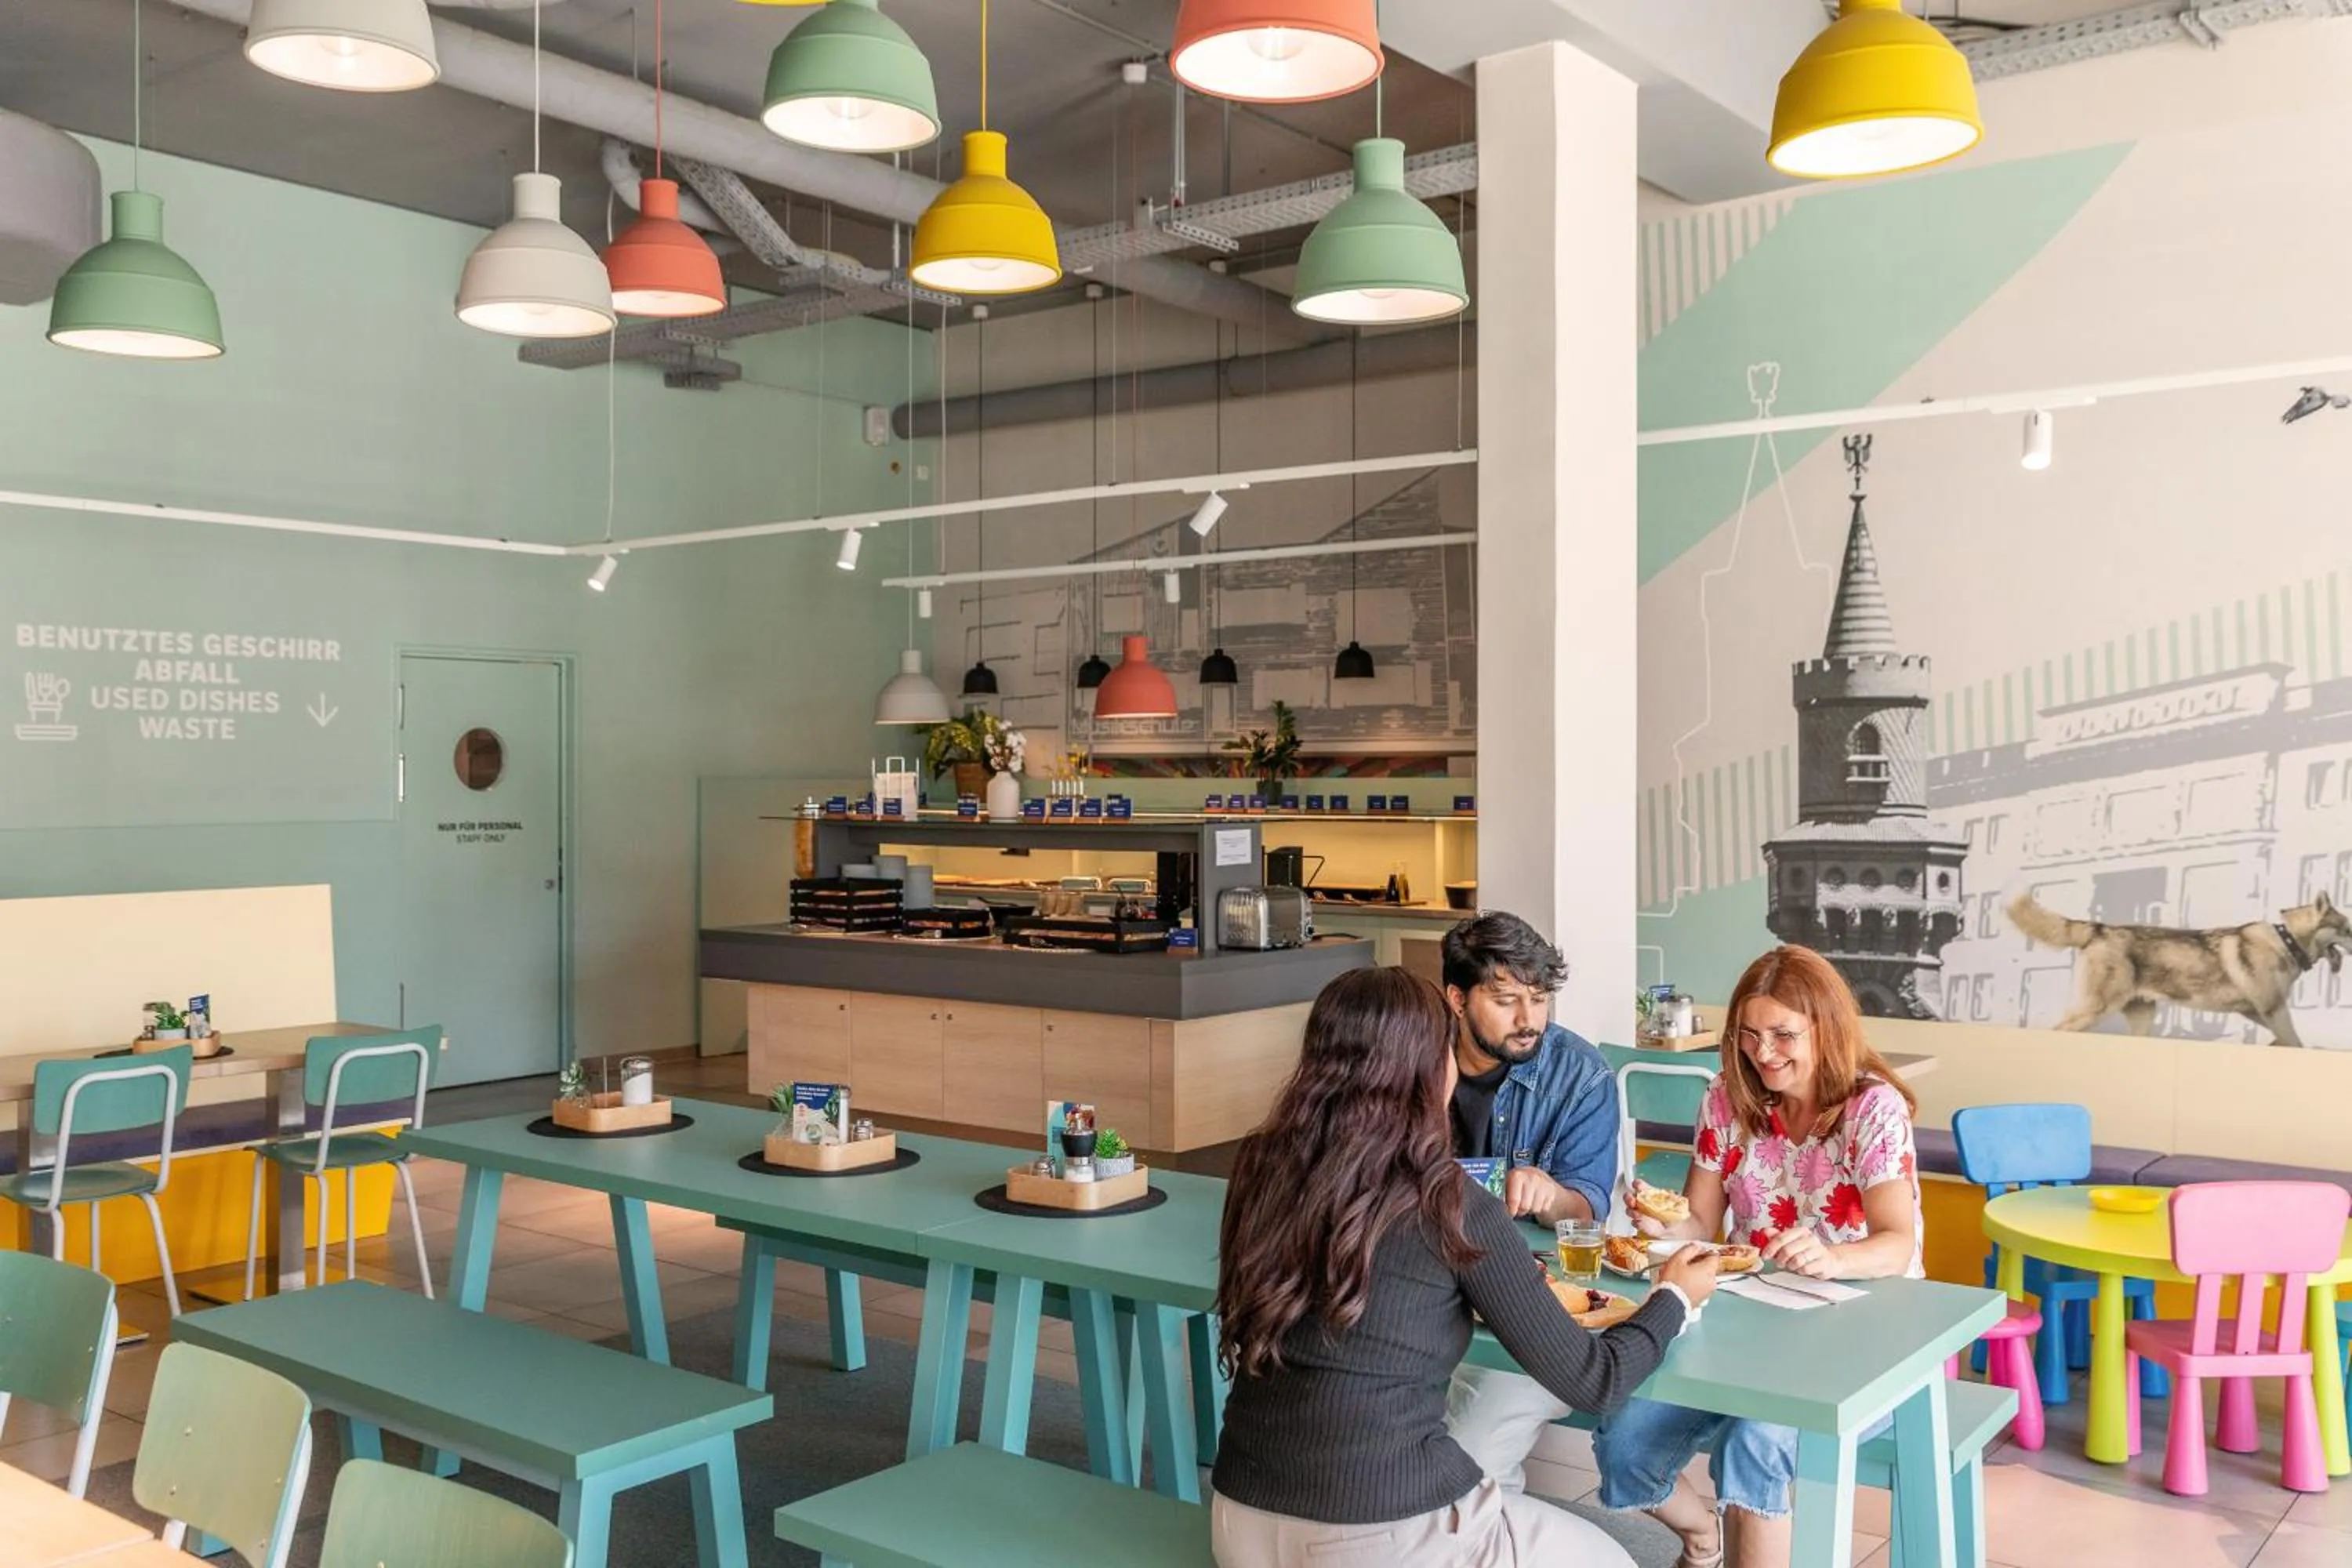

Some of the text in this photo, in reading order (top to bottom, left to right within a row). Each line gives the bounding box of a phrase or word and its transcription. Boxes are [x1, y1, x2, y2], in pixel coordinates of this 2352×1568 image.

[16, 623, 341, 661] BENUTZTES GESCHIRR
[135, 659, 240, 684] ABFALL
[91, 686, 280, 713] USED DISHES
[139, 717, 235, 739] WASTE
[437, 822, 456, 831] NUR
[477, 822, 523, 830] PERSONAL
[456, 834, 505, 843] STAFF ONLY
